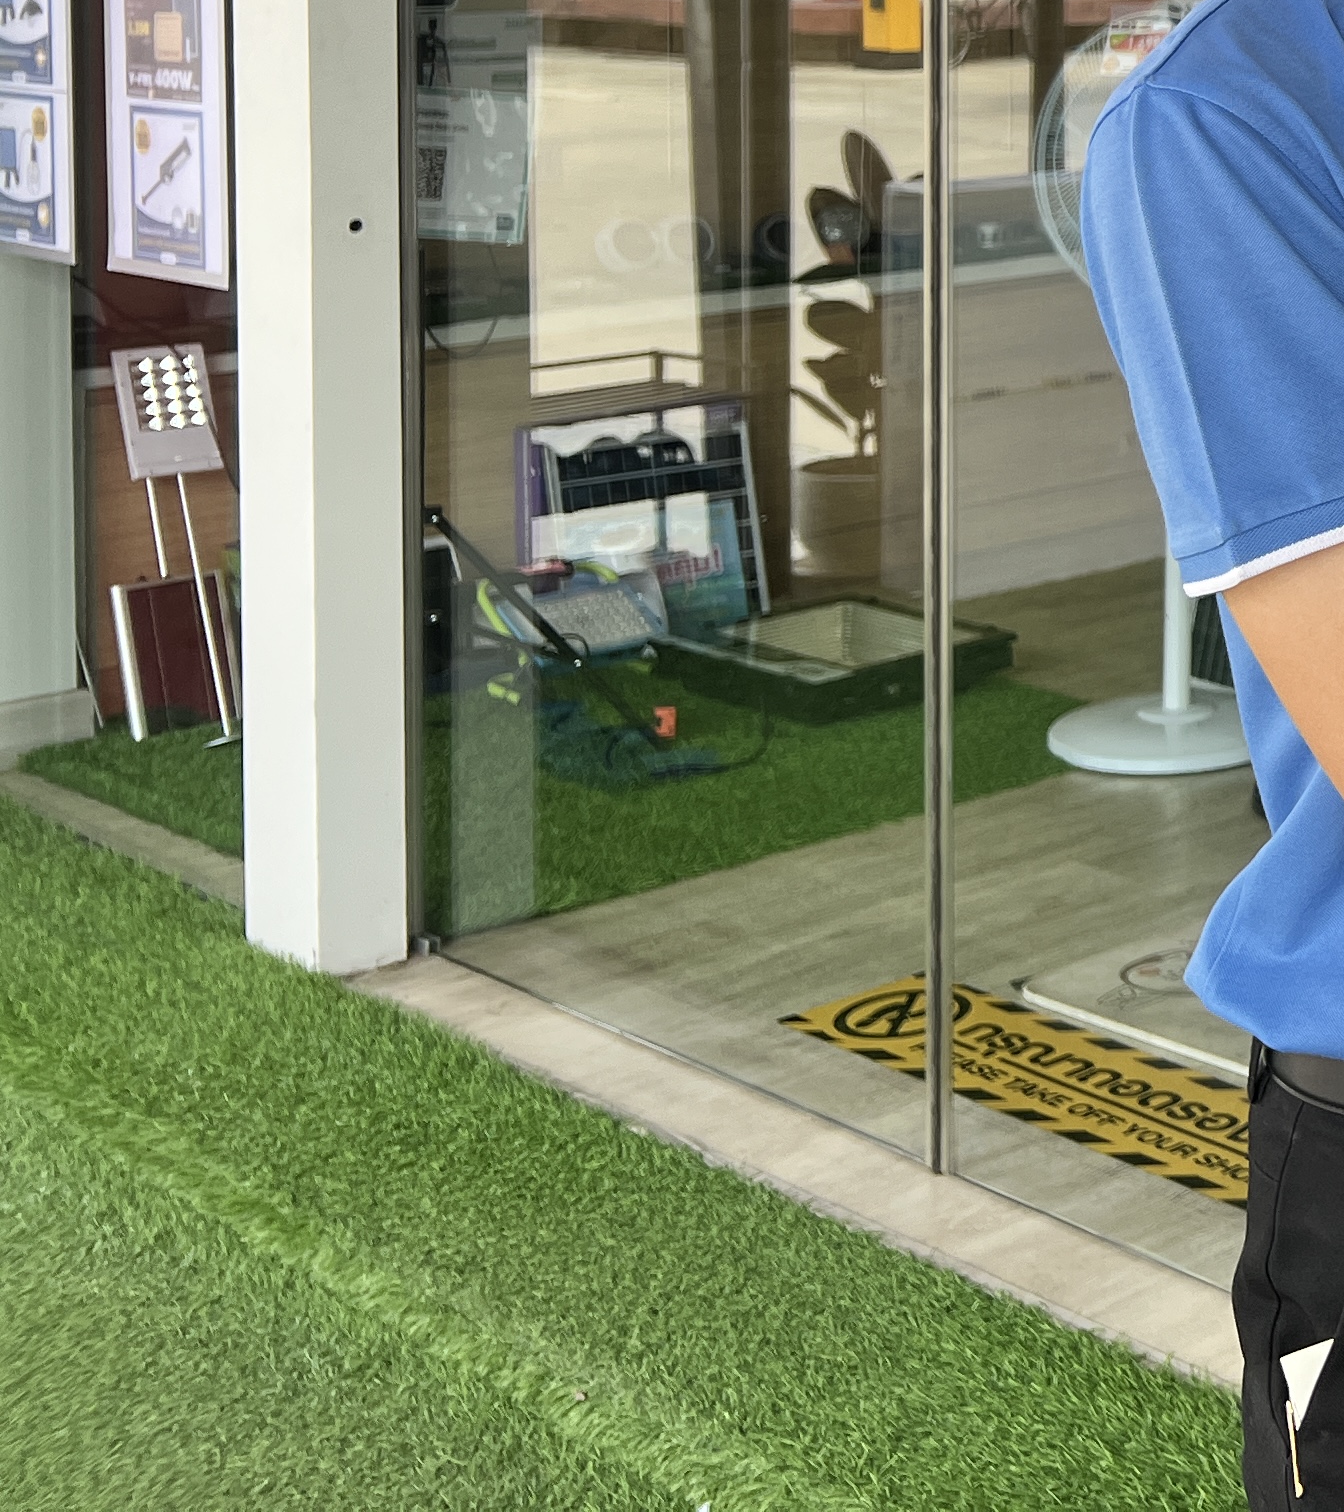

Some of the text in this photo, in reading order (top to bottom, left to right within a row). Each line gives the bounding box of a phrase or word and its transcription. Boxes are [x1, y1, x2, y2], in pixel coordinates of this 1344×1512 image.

[1001, 1074, 1073, 1108] TAKE
[1067, 1101, 1128, 1127] OFF
[1121, 1123, 1198, 1158] YOUR
